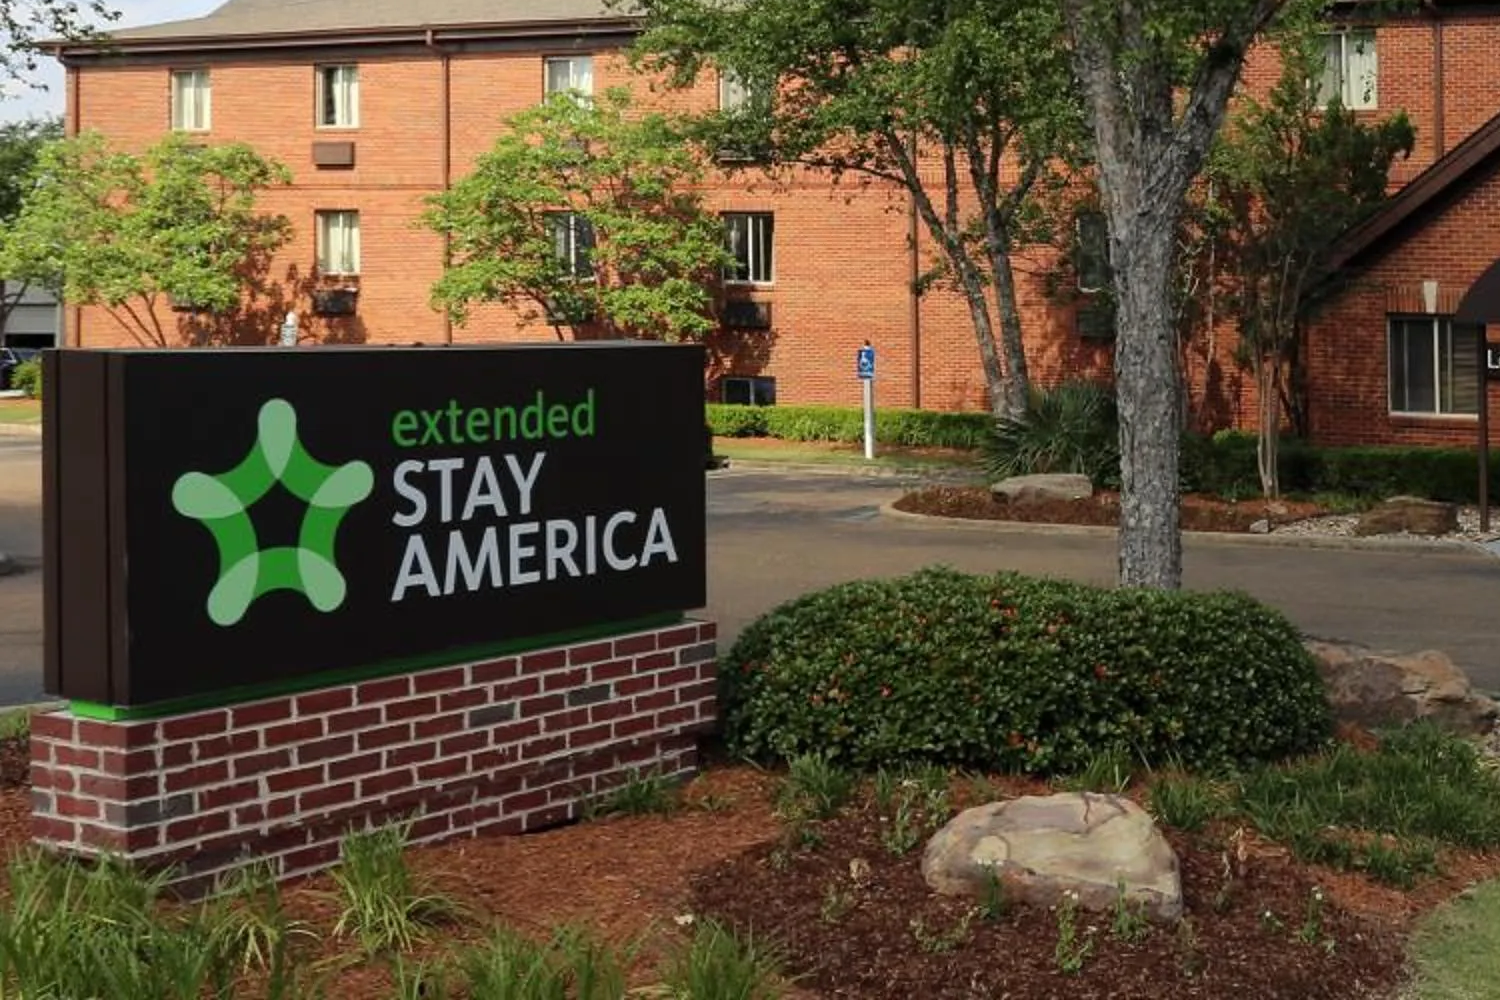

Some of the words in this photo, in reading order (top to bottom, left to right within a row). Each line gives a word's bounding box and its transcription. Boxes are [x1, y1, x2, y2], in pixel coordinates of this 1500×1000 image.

[391, 387, 596, 447] extended
[391, 451, 547, 527] STAY
[390, 507, 679, 602] AMERICA
